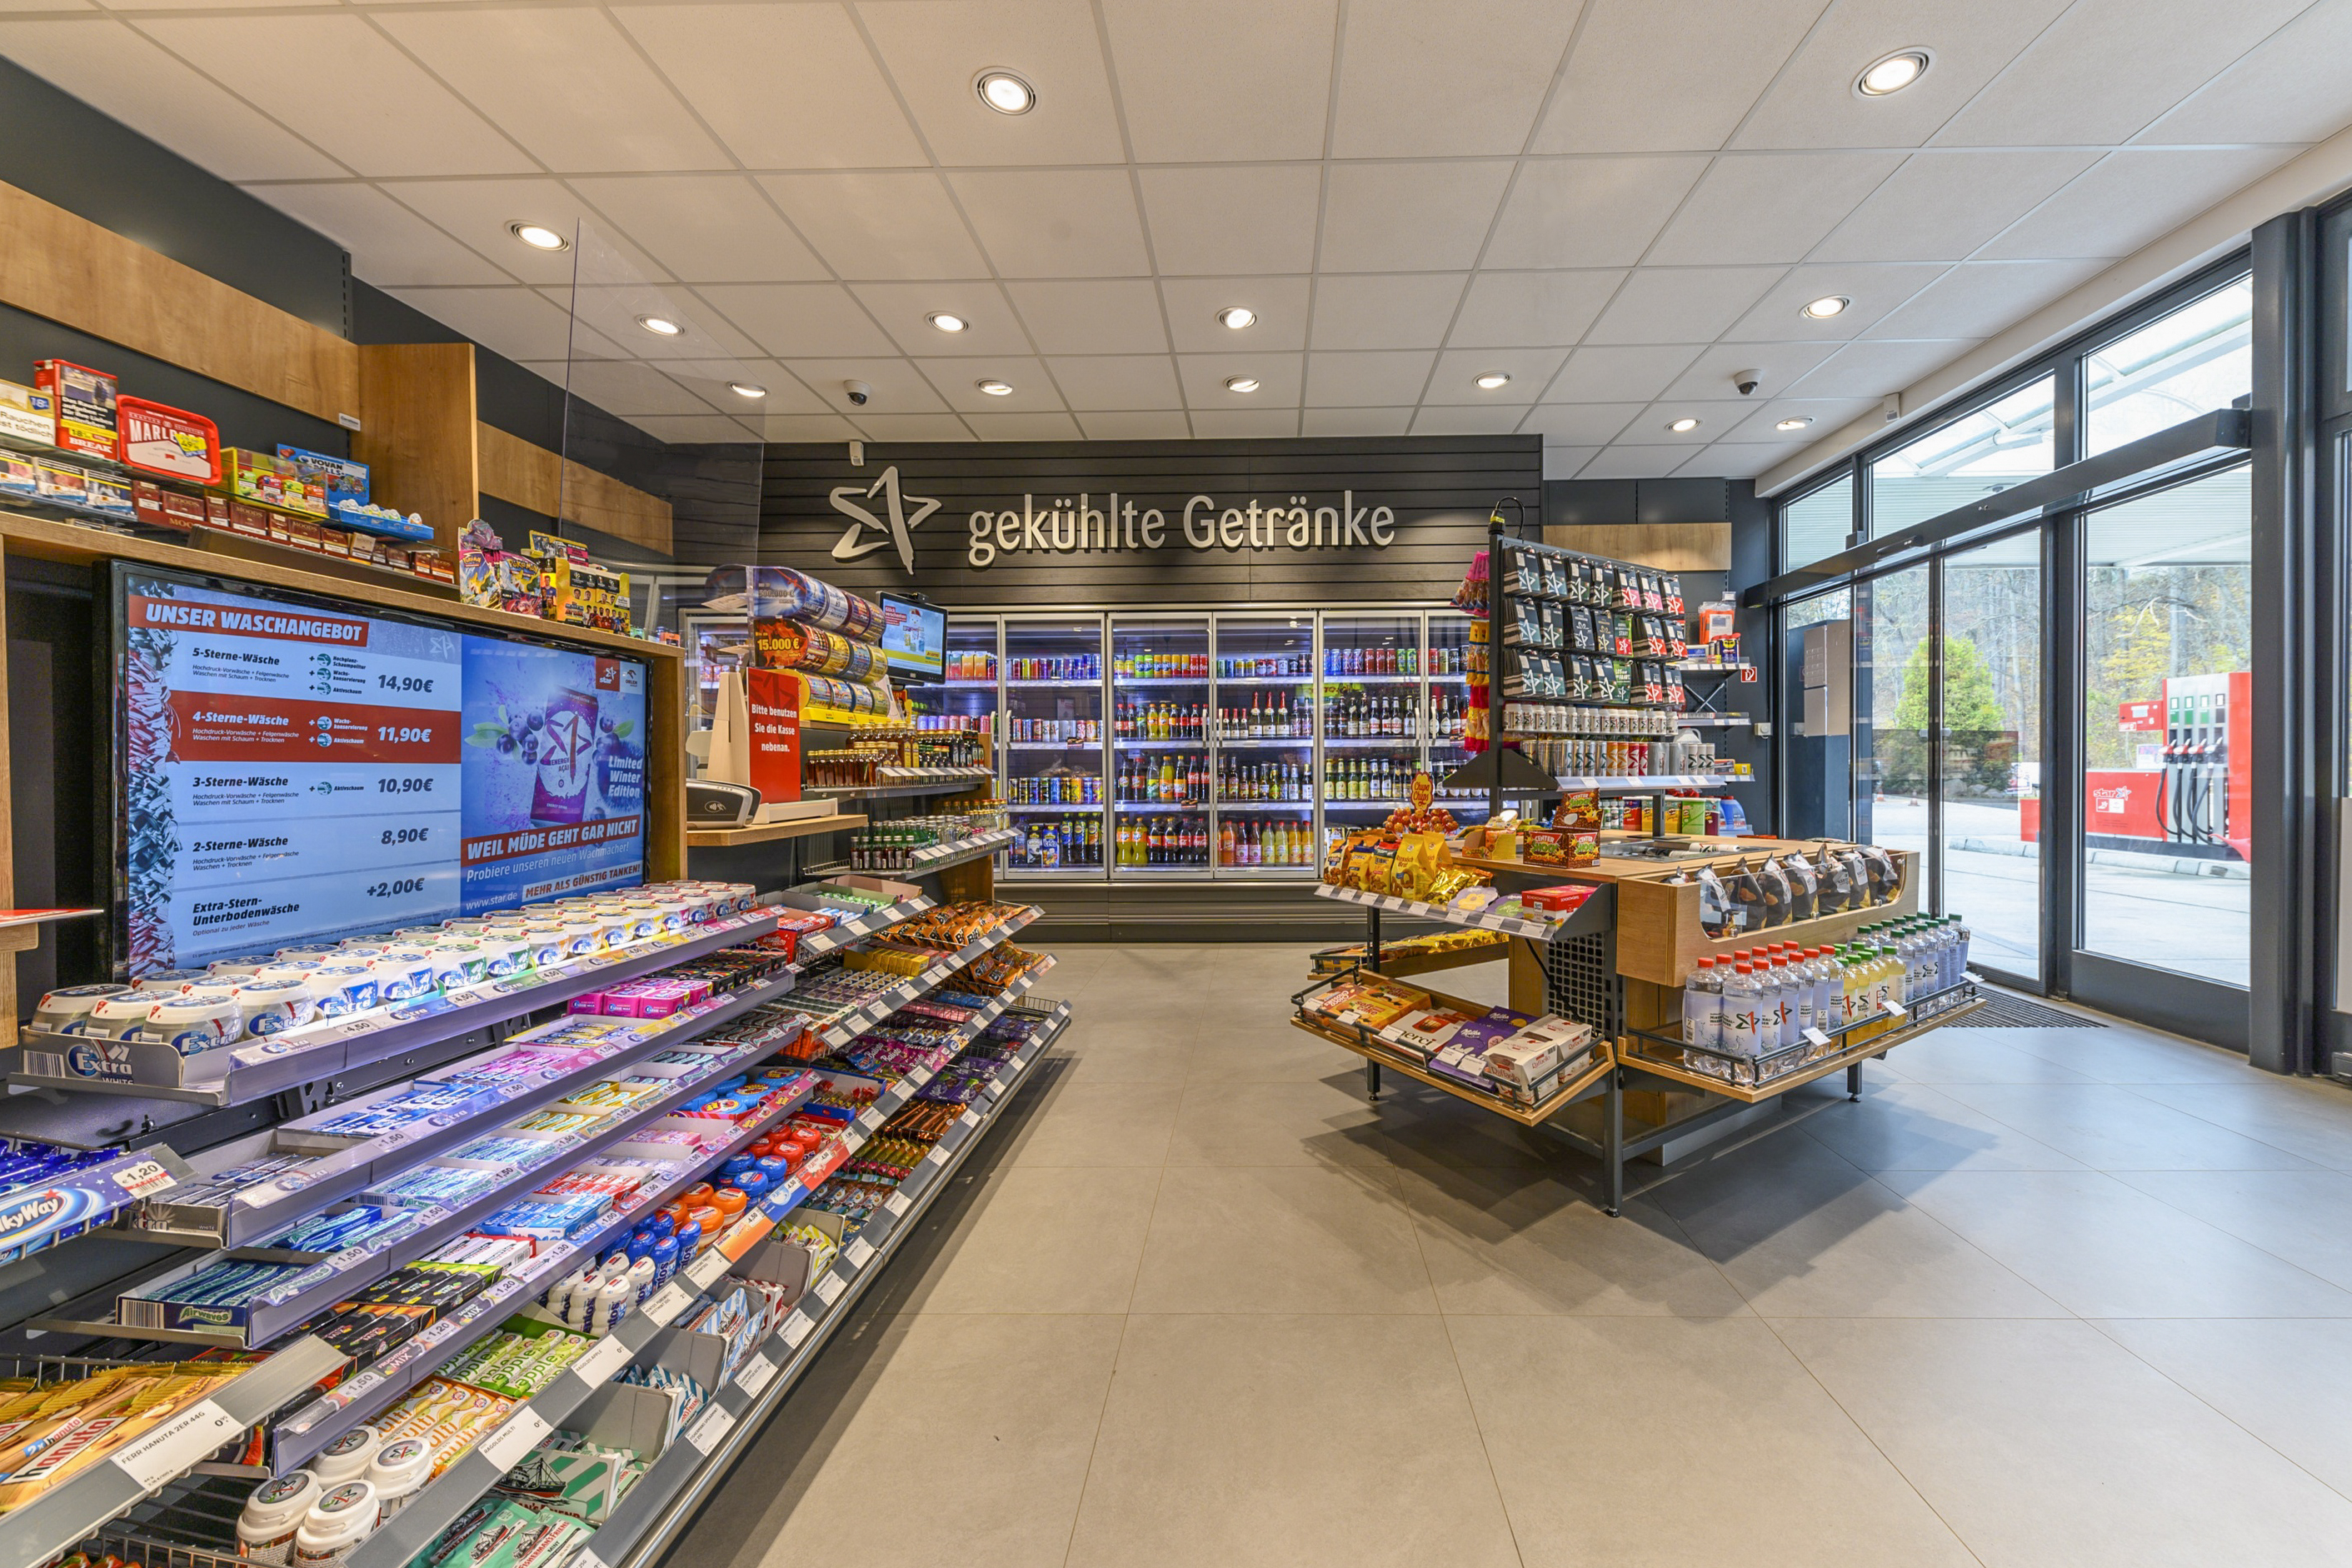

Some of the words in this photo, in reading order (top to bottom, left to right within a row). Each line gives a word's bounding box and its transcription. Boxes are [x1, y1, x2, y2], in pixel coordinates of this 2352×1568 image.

[68, 437, 112, 453] BREAK
[311, 458, 343, 471] VOVAN
[969, 492, 1166, 567] gekühlte
[1184, 490, 1395, 551] Getränke
[146, 603, 215, 627] UNSER
[221, 612, 362, 642] WASCHANGEBOT
[757, 638, 791, 651] 15.000
[793, 638, 800, 650] €
[192, 647, 280, 665] 5-Sterne-Wäsche
[192, 664, 250, 674] Hochdruck-Vorwäsche
[378, 674, 434, 693] 14,90€
[599, 677, 612, 685] star
[192, 712, 289, 726] 4-Sterne-Wäsche
[752, 704, 768, 715] Bitte
[769, 707, 797, 718] benutzen
[192, 728, 256, 737] Hochdruck-Vorwäsche
[378, 727, 432, 743] 11,90€
[755, 723, 766, 733] Sie
[767, 723, 777, 733] die
[778, 725, 796, 735] Kasse
[762, 742, 791, 752] nebenan.
[551, 757, 570, 766] ENERGY
[608, 755, 643, 770] Limited
[192, 777, 288, 787] 3-Sterne-Wäsche
[610, 770, 641, 784] Winter
[377, 778, 433, 794] 10,90€
[608, 785, 641, 797] Edition
[2094, 788, 2116, 798] star
[192, 836, 288, 852] 2-Sterne-Wäsche
[381, 827, 429, 846] 8,90€
[467, 841, 504, 860] WEIL
[507, 831, 545, 853] MÜDE
[548, 827, 578, 845] GEHT
[582, 823, 604, 840] GAR
[607, 818, 638, 836] NICHT
[1535, 835, 1555, 843] CENTER
[193, 855, 257, 865] Hochdruck-Vorwäsche
[227, 860, 252, 868] Trocknen
[467, 863, 510, 882] Probiere
[513, 859, 549, 876] unseren
[551, 853, 577, 865] neuen
[579, 841, 630, 861] Wachmacher!
[367, 877, 426, 898] +2,00€
[525, 885, 552, 898] MEHR
[555, 880, 571, 893] ALS
[572, 870, 607, 889] GÜNSTIG
[608, 863, 641, 881] TANKEN!
[192, 896, 262, 914] Extra-Stern-
[466, 891, 518, 911] www.star.de
[193, 903, 300, 926] Unterbodenwäsche
[192, 927, 220, 936] Optional
[230, 923, 246, 931] jeder
[247, 920, 270, 928] Wäsche
[493, 961, 527, 975] Extra
[445, 971, 482, 986] Extra
[392, 984, 430, 998] Extra
[1385, 985, 1404, 994] soft
[1388, 989, 1408, 1000] cake
[323, 997, 372, 1016] Extra
[1355, 1000, 1374, 1011] soft
[1356, 1005, 1378, 1016] cake
[259, 1012, 310, 1034] Extra
[181, 1031, 239, 1052] Extra
[77, 1053, 132, 1075] Extra
[122, 1165, 159, 1185] €1,20
[335, 1248, 363, 1267] €1,50
[269, 1266, 332, 1301] Airwaves
[180, 1306, 232, 1324] Airwaves
[463, 1305, 483, 1320] MIX
[377, 1346, 412, 1369] FRUCHTIGER
[390, 1353, 413, 1370] MIX
[492, 1348, 536, 1382] apple
[575, 1358, 592, 1373] RAGOLDS
[590, 1349, 603, 1361] APPLE
[516, 1355, 559, 1389] apple
[345, 1375, 373, 1396] €1,50
[47, 1418, 81, 1445] hanuta
[122, 1450, 142, 1465] FERR
[142, 1430, 175, 1451] HANUTA
[174, 1421, 190, 1432] 2ER
[190, 1411, 206, 1423] 44G
[483, 1436, 504, 1454] RAGOLDS
[502, 1426, 517, 1438] MULTI
[12, 1420, 117, 1480] hanuta
[551, 1521, 570, 1538] FRIEND
[547, 1541, 561, 1554] MINT
